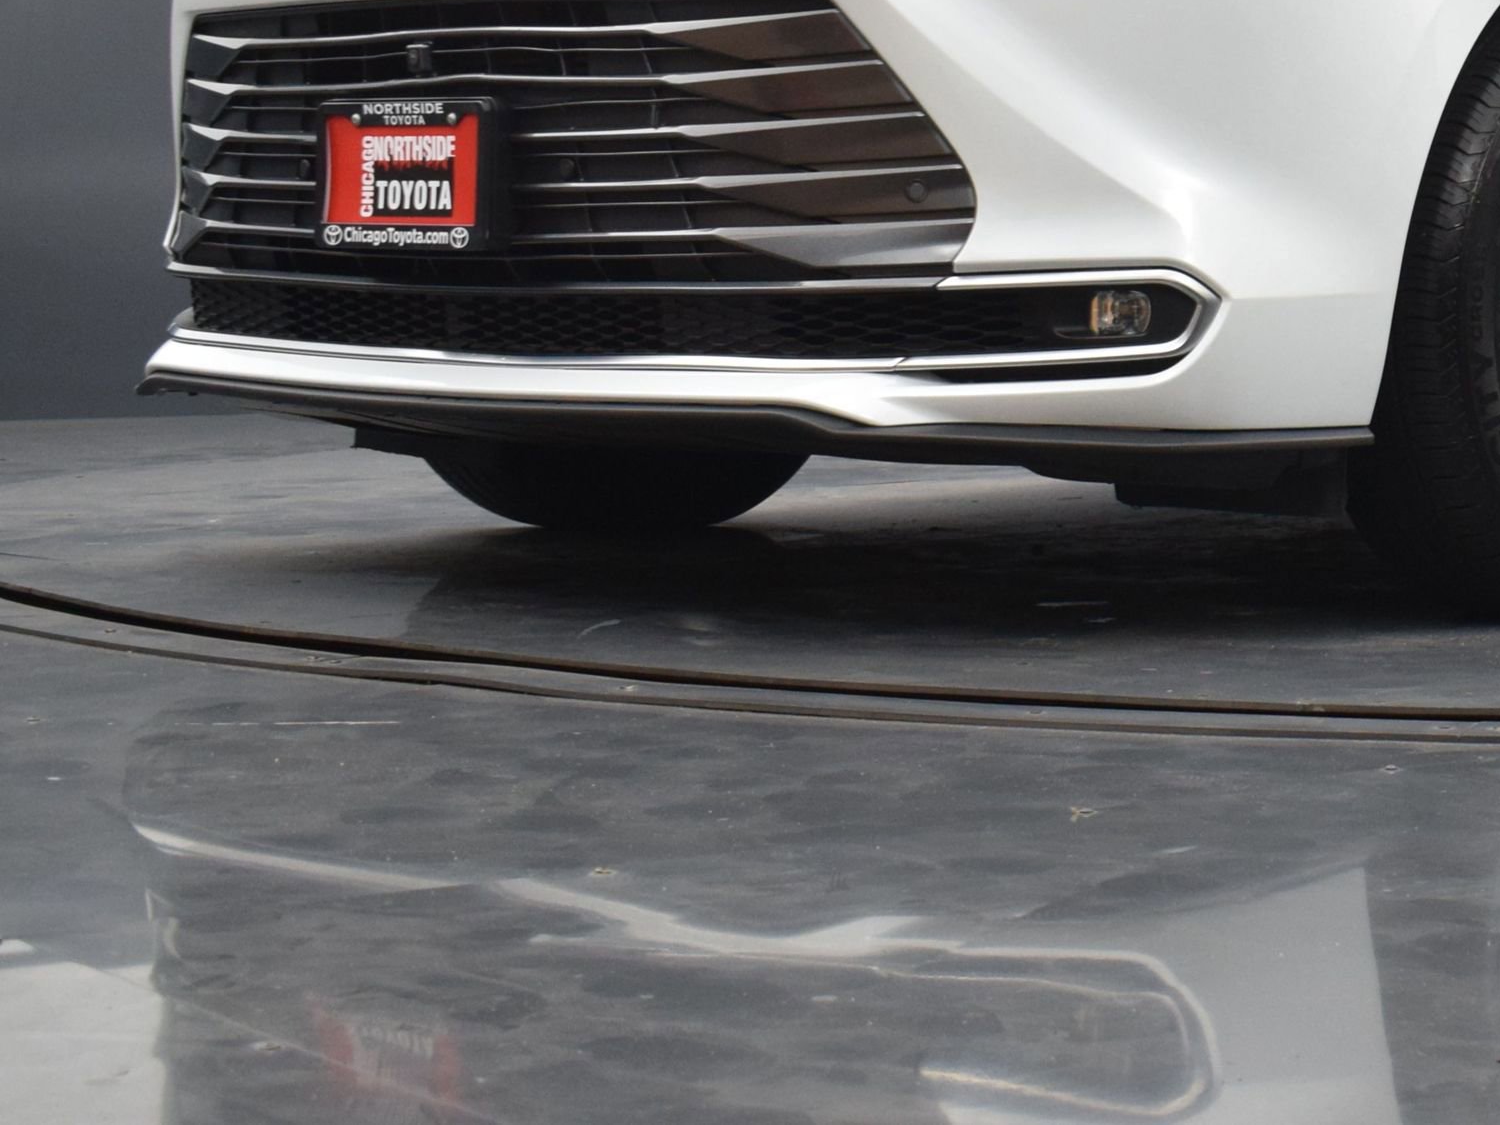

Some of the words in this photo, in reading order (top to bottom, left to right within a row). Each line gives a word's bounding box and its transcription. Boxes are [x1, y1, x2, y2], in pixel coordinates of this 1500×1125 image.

[363, 103, 444, 115] NORTHSIDE
[383, 115, 426, 125] TOYOTA
[374, 135, 456, 161] NORTHSIDE
[360, 136, 375, 217] CHICAGO
[376, 180, 452, 210] TOYOTA
[343, 227, 449, 246] ChicagoToyota.com
